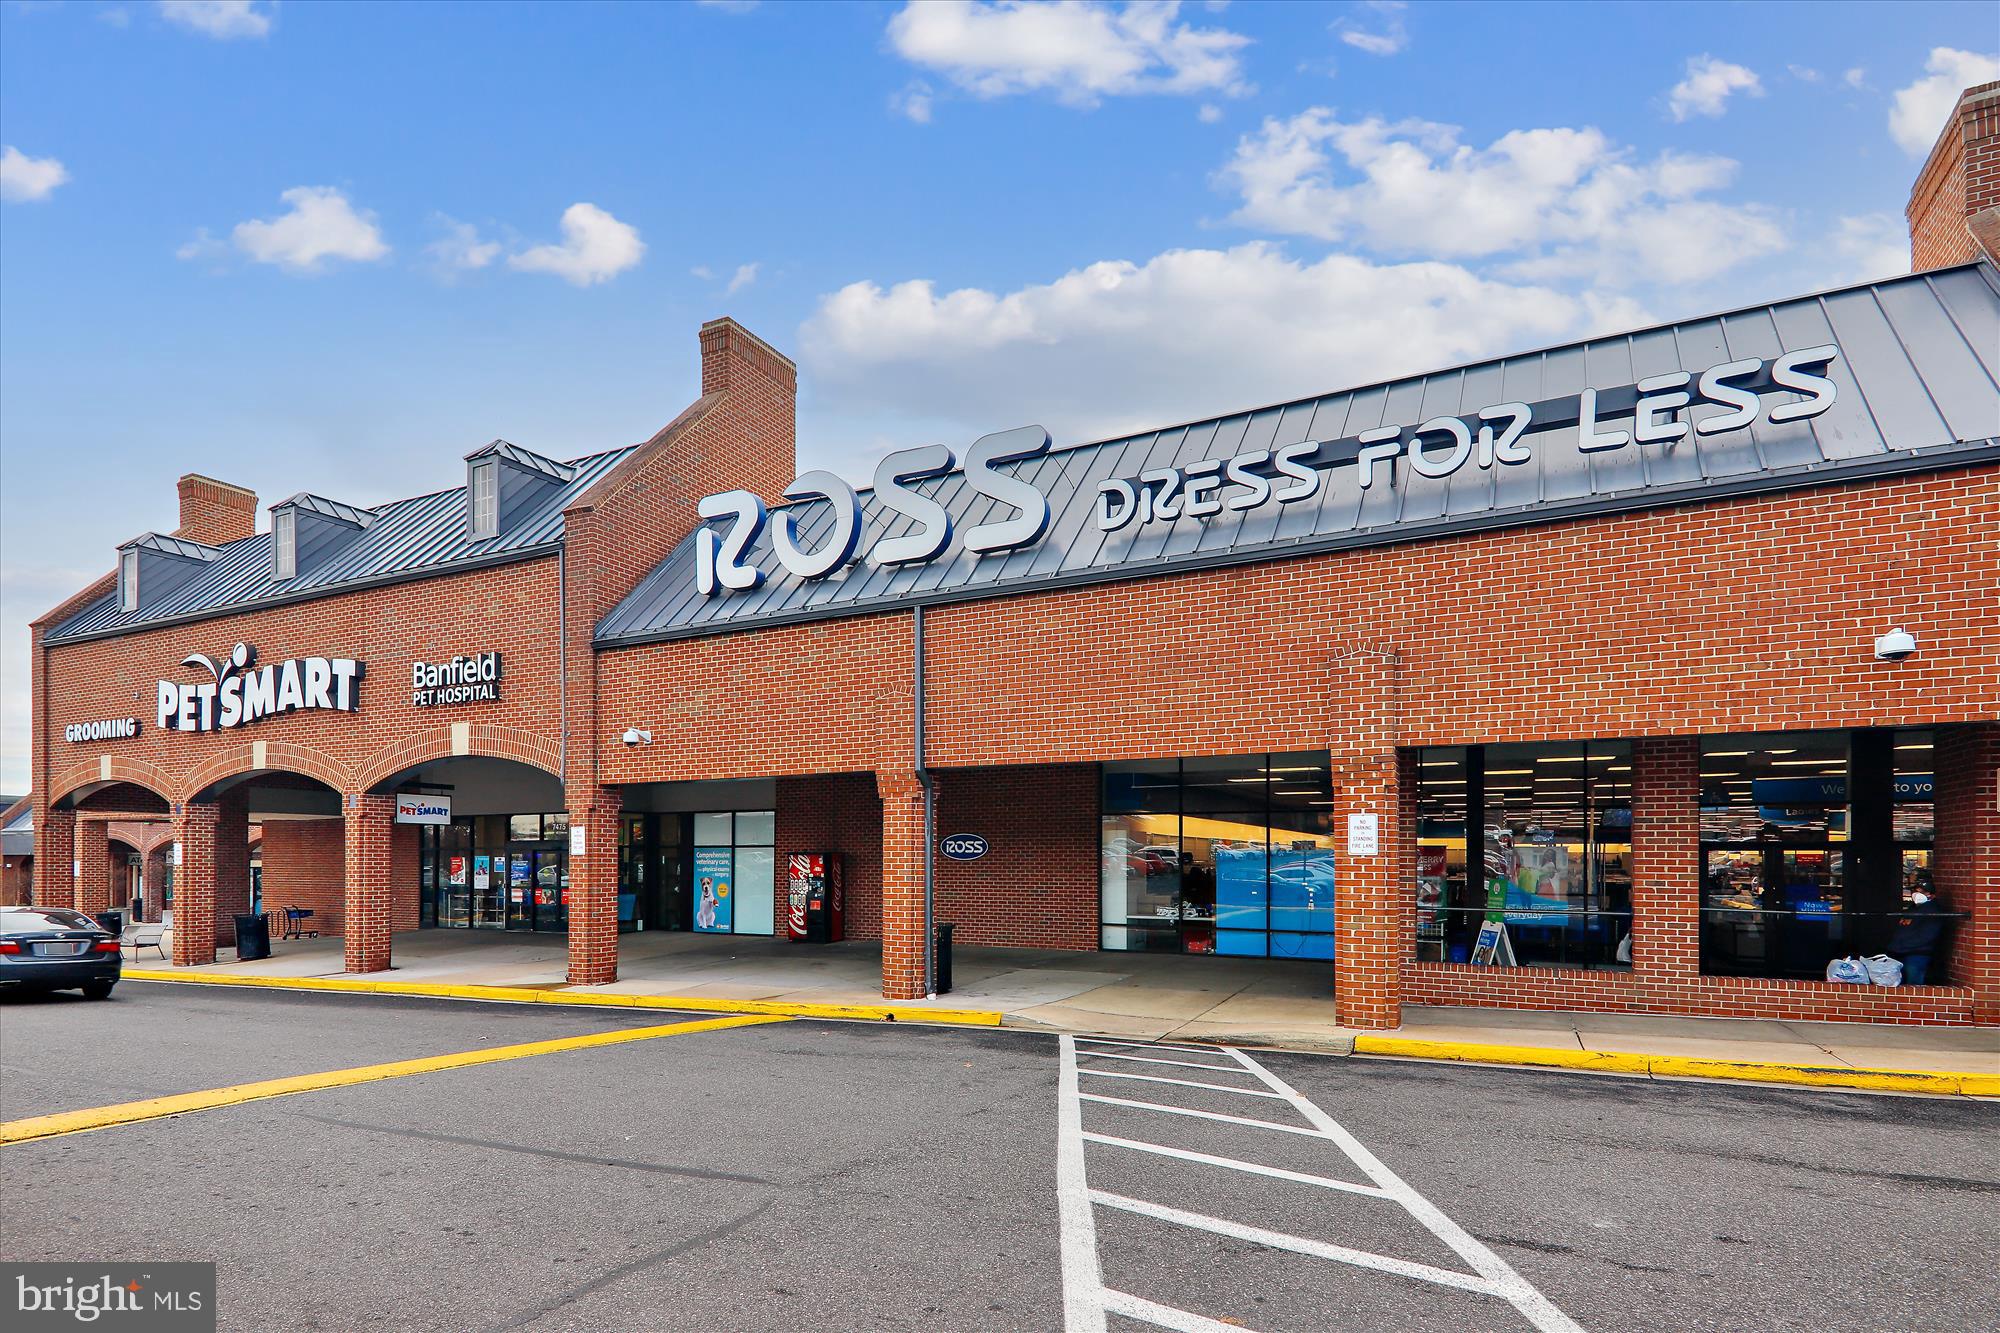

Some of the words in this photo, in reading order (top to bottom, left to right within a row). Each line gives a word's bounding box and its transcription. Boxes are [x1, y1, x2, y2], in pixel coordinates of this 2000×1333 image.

[1096, 439, 1320, 532] DRESS
[1357, 400, 1533, 490] FOR
[1578, 343, 1840, 454] LESS
[696, 424, 1051, 597] ROSS
[413, 651, 497, 688] Banfield
[157, 655, 360, 732] PETSMART
[413, 690, 433, 706] PET
[437, 684, 497, 704] HOSPITAL
[65, 716, 138, 743] GROOMING
[1893, 783, 1910, 792] to
[399, 805, 449, 817] PETSMART
[553, 823, 567, 831] 7475
[946, 840, 984, 854] ROSS
[1503, 912, 1544, 921] everyday
